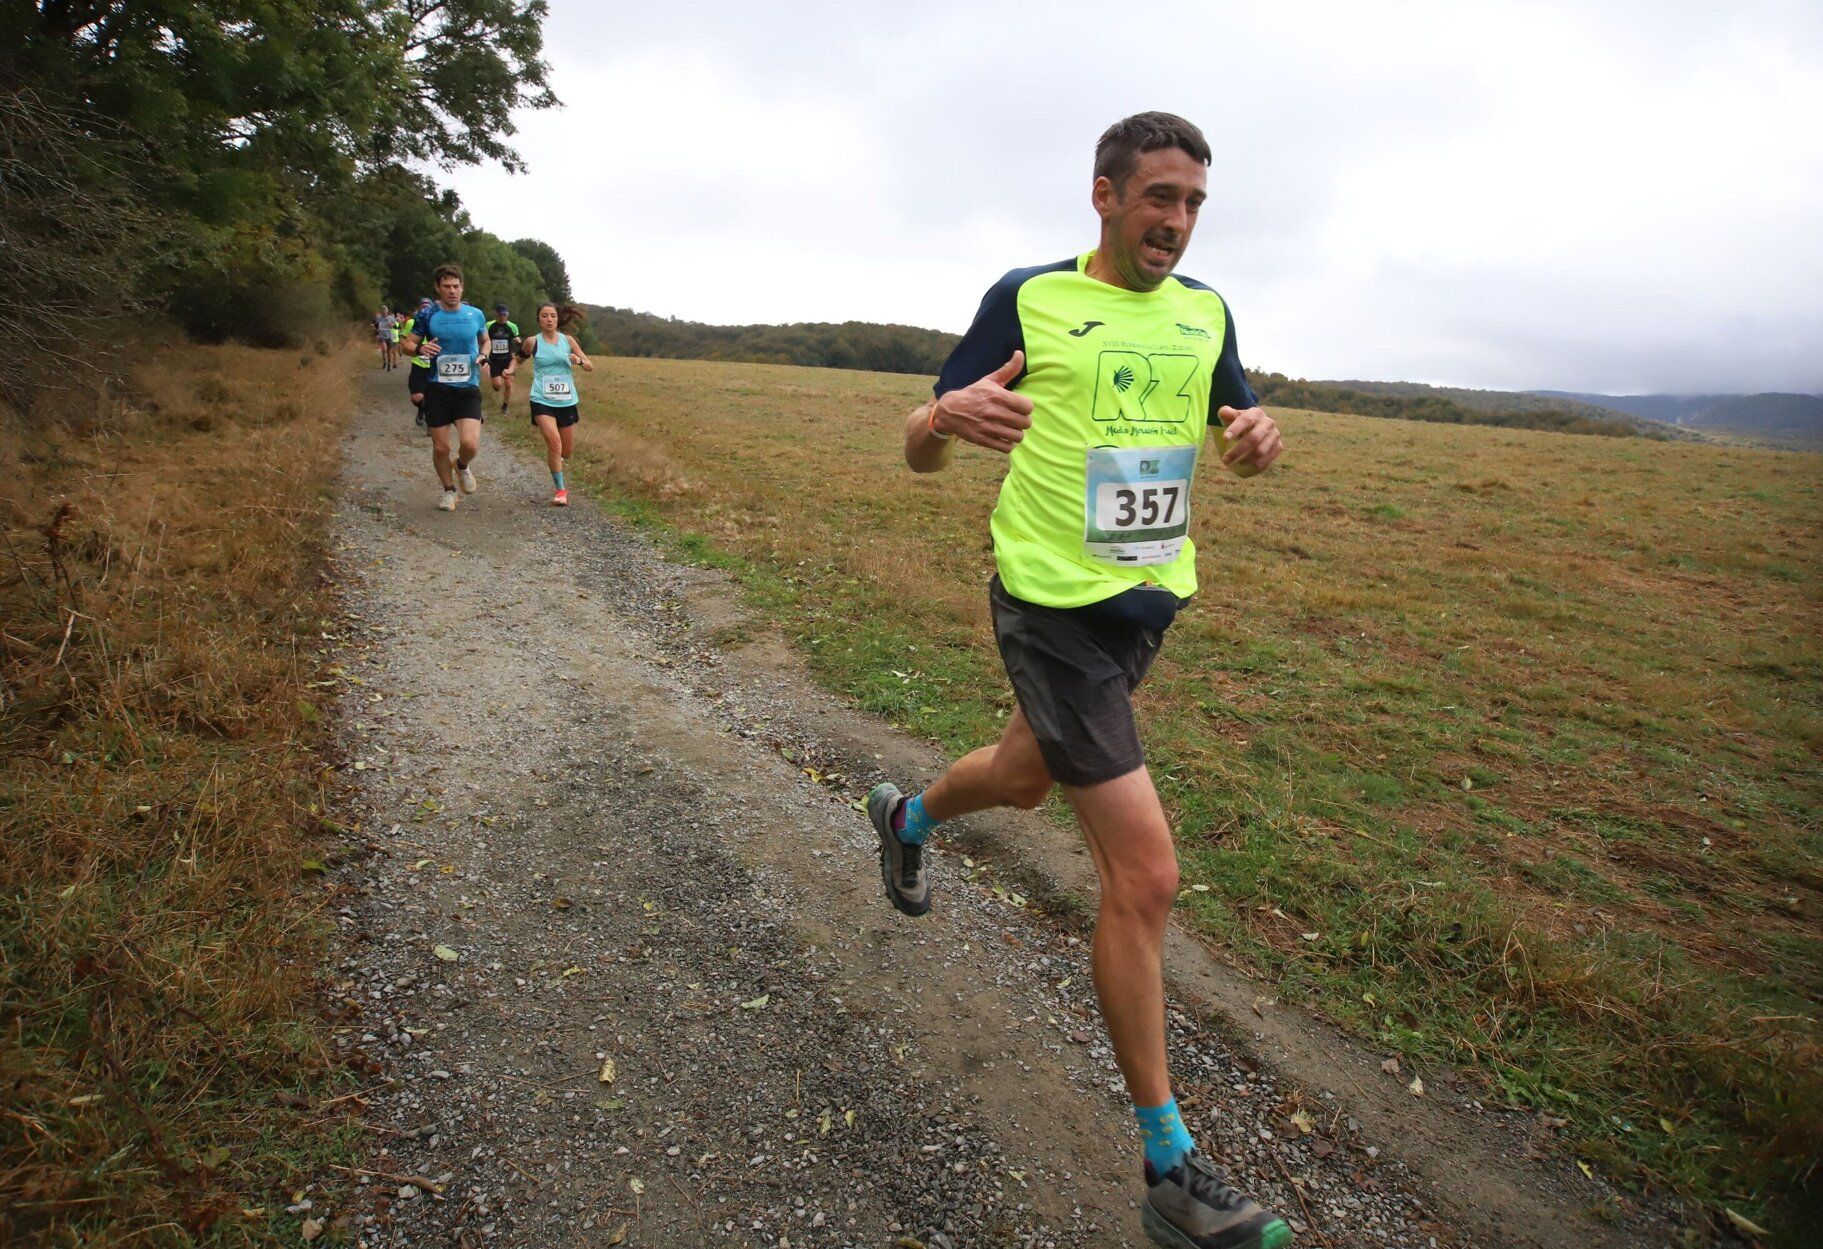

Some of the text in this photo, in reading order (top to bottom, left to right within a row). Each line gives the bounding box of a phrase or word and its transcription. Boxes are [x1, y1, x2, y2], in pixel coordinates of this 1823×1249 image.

[445, 363, 464, 373] 275
[549, 383, 565, 391] 507
[1115, 487, 1179, 527] 357
